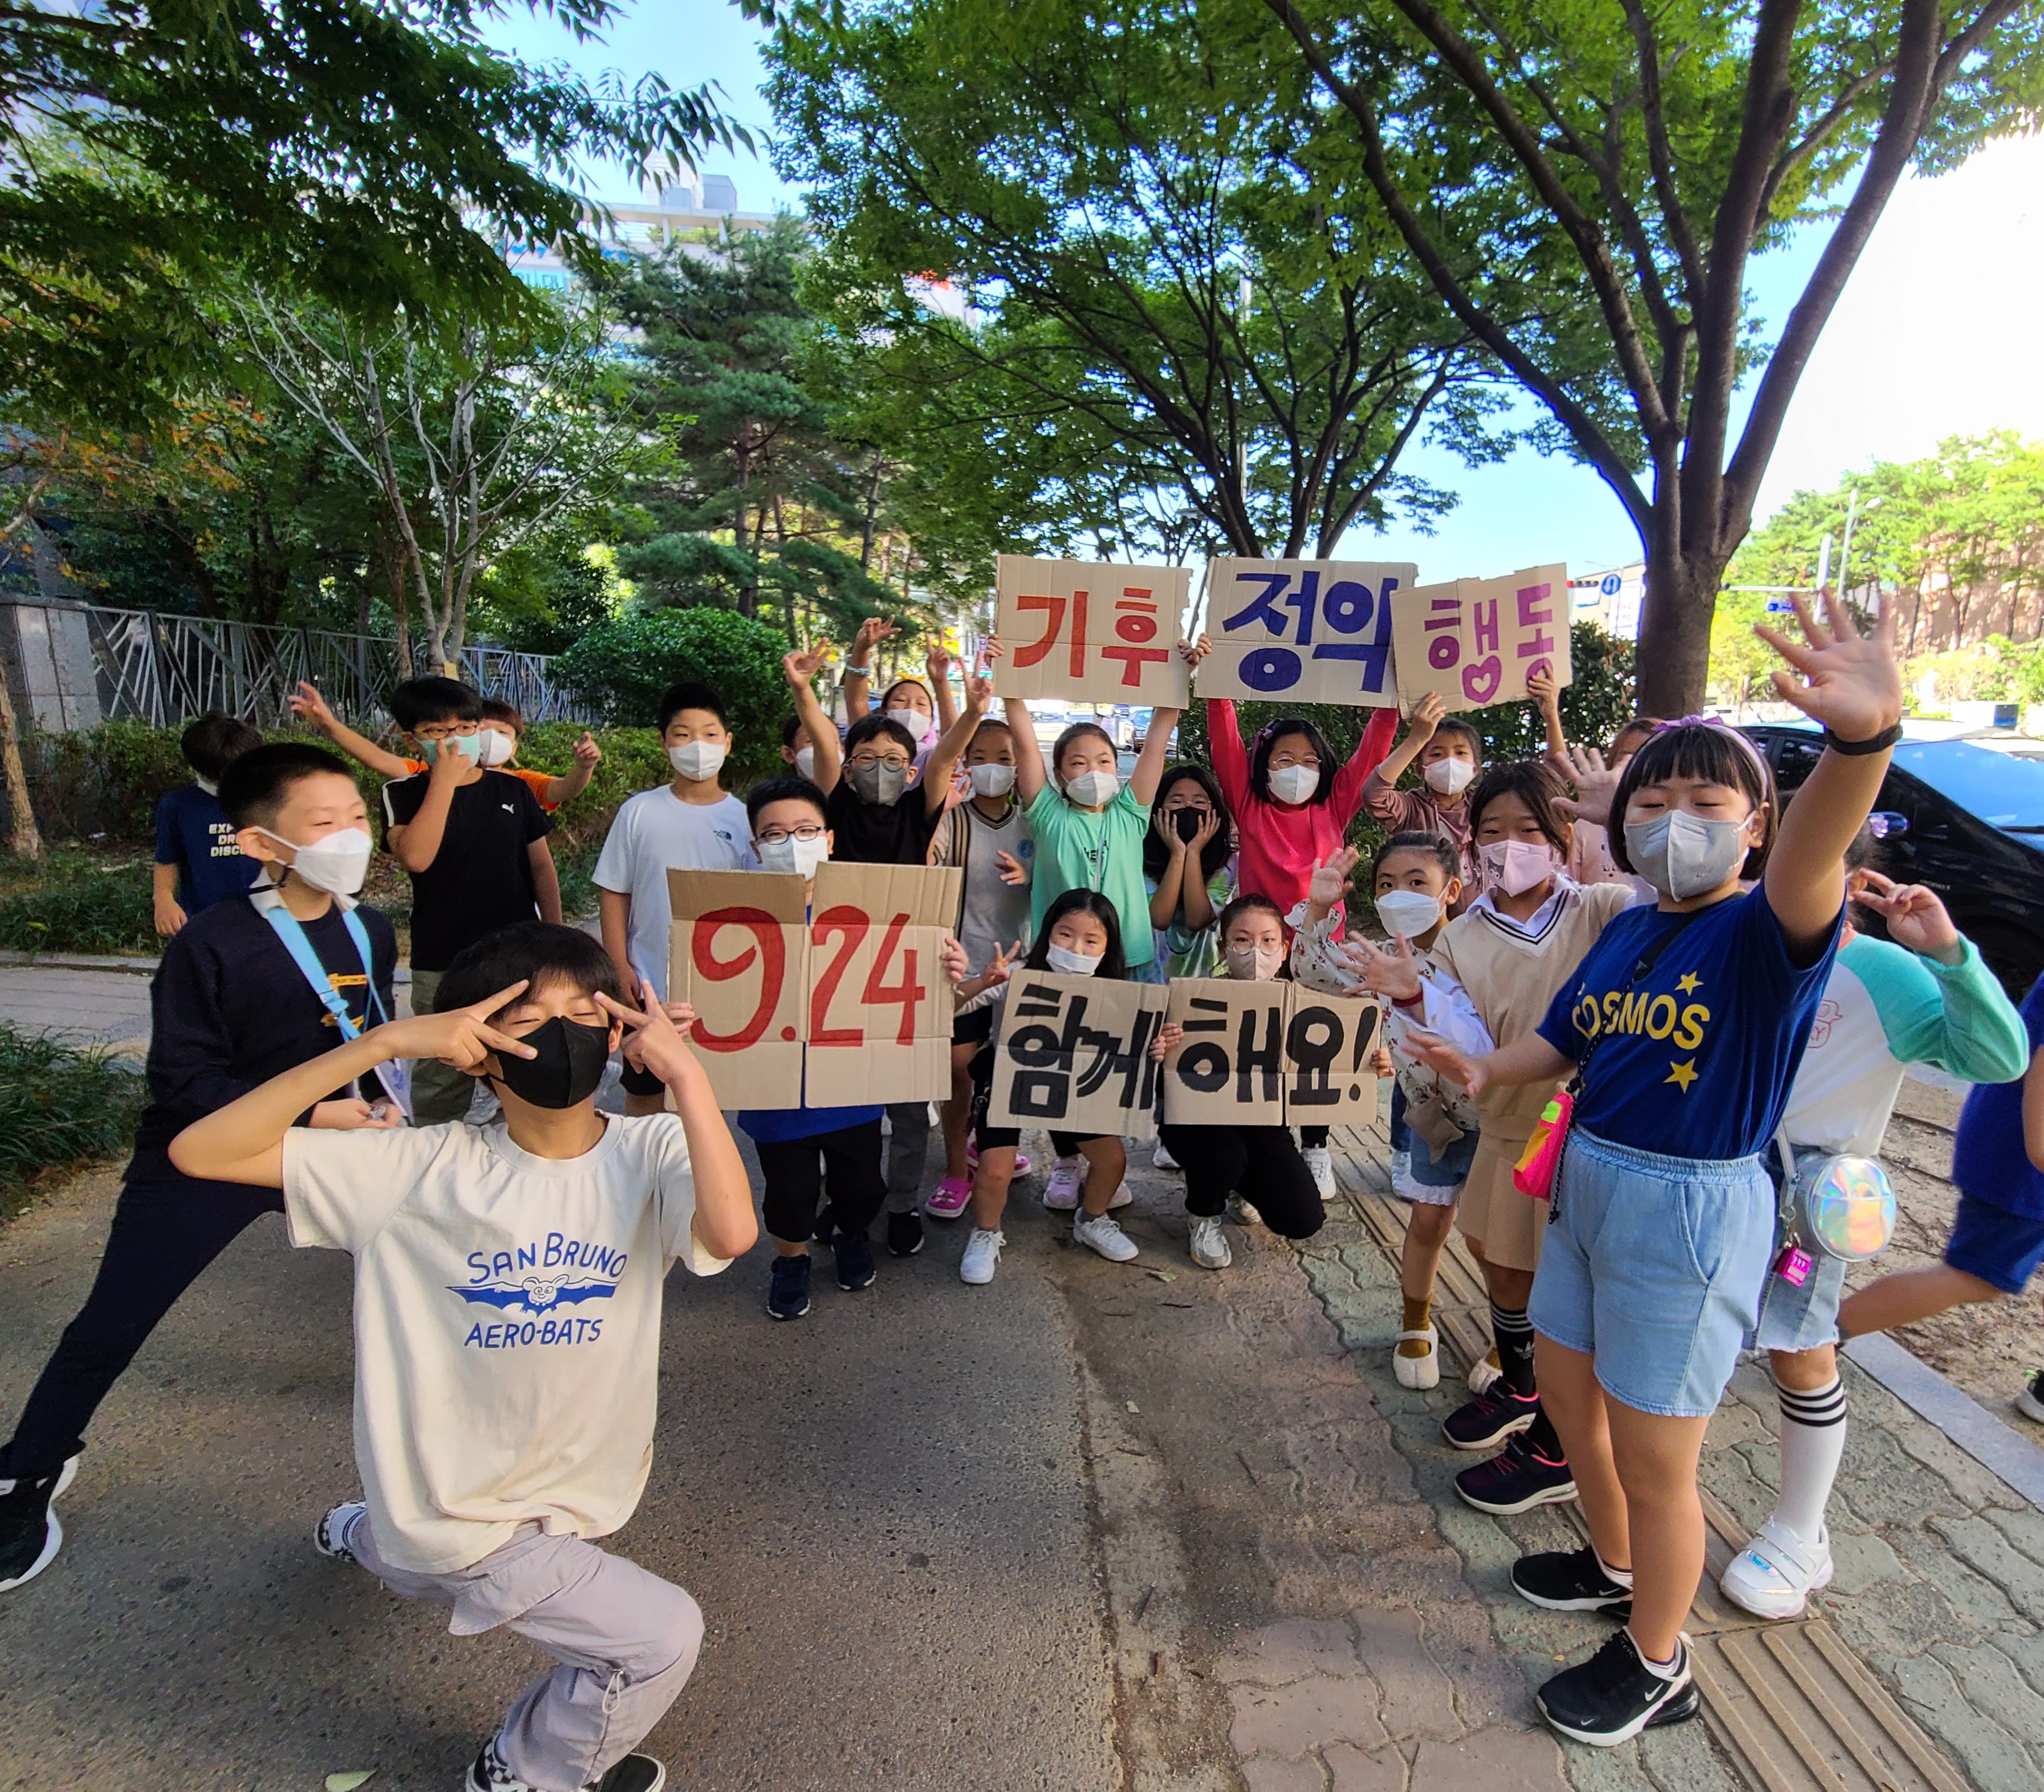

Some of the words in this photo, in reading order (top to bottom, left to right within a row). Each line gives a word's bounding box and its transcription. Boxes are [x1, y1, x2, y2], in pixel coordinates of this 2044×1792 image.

[1013, 587, 1169, 687] 기후
[1424, 583, 1554, 703] 행동
[690, 905, 926, 1053] 9.24
[466, 1242, 536, 1284] SAN
[543, 1231, 628, 1278] BRUNO
[463, 1318, 604, 1349] AERO-BATS
